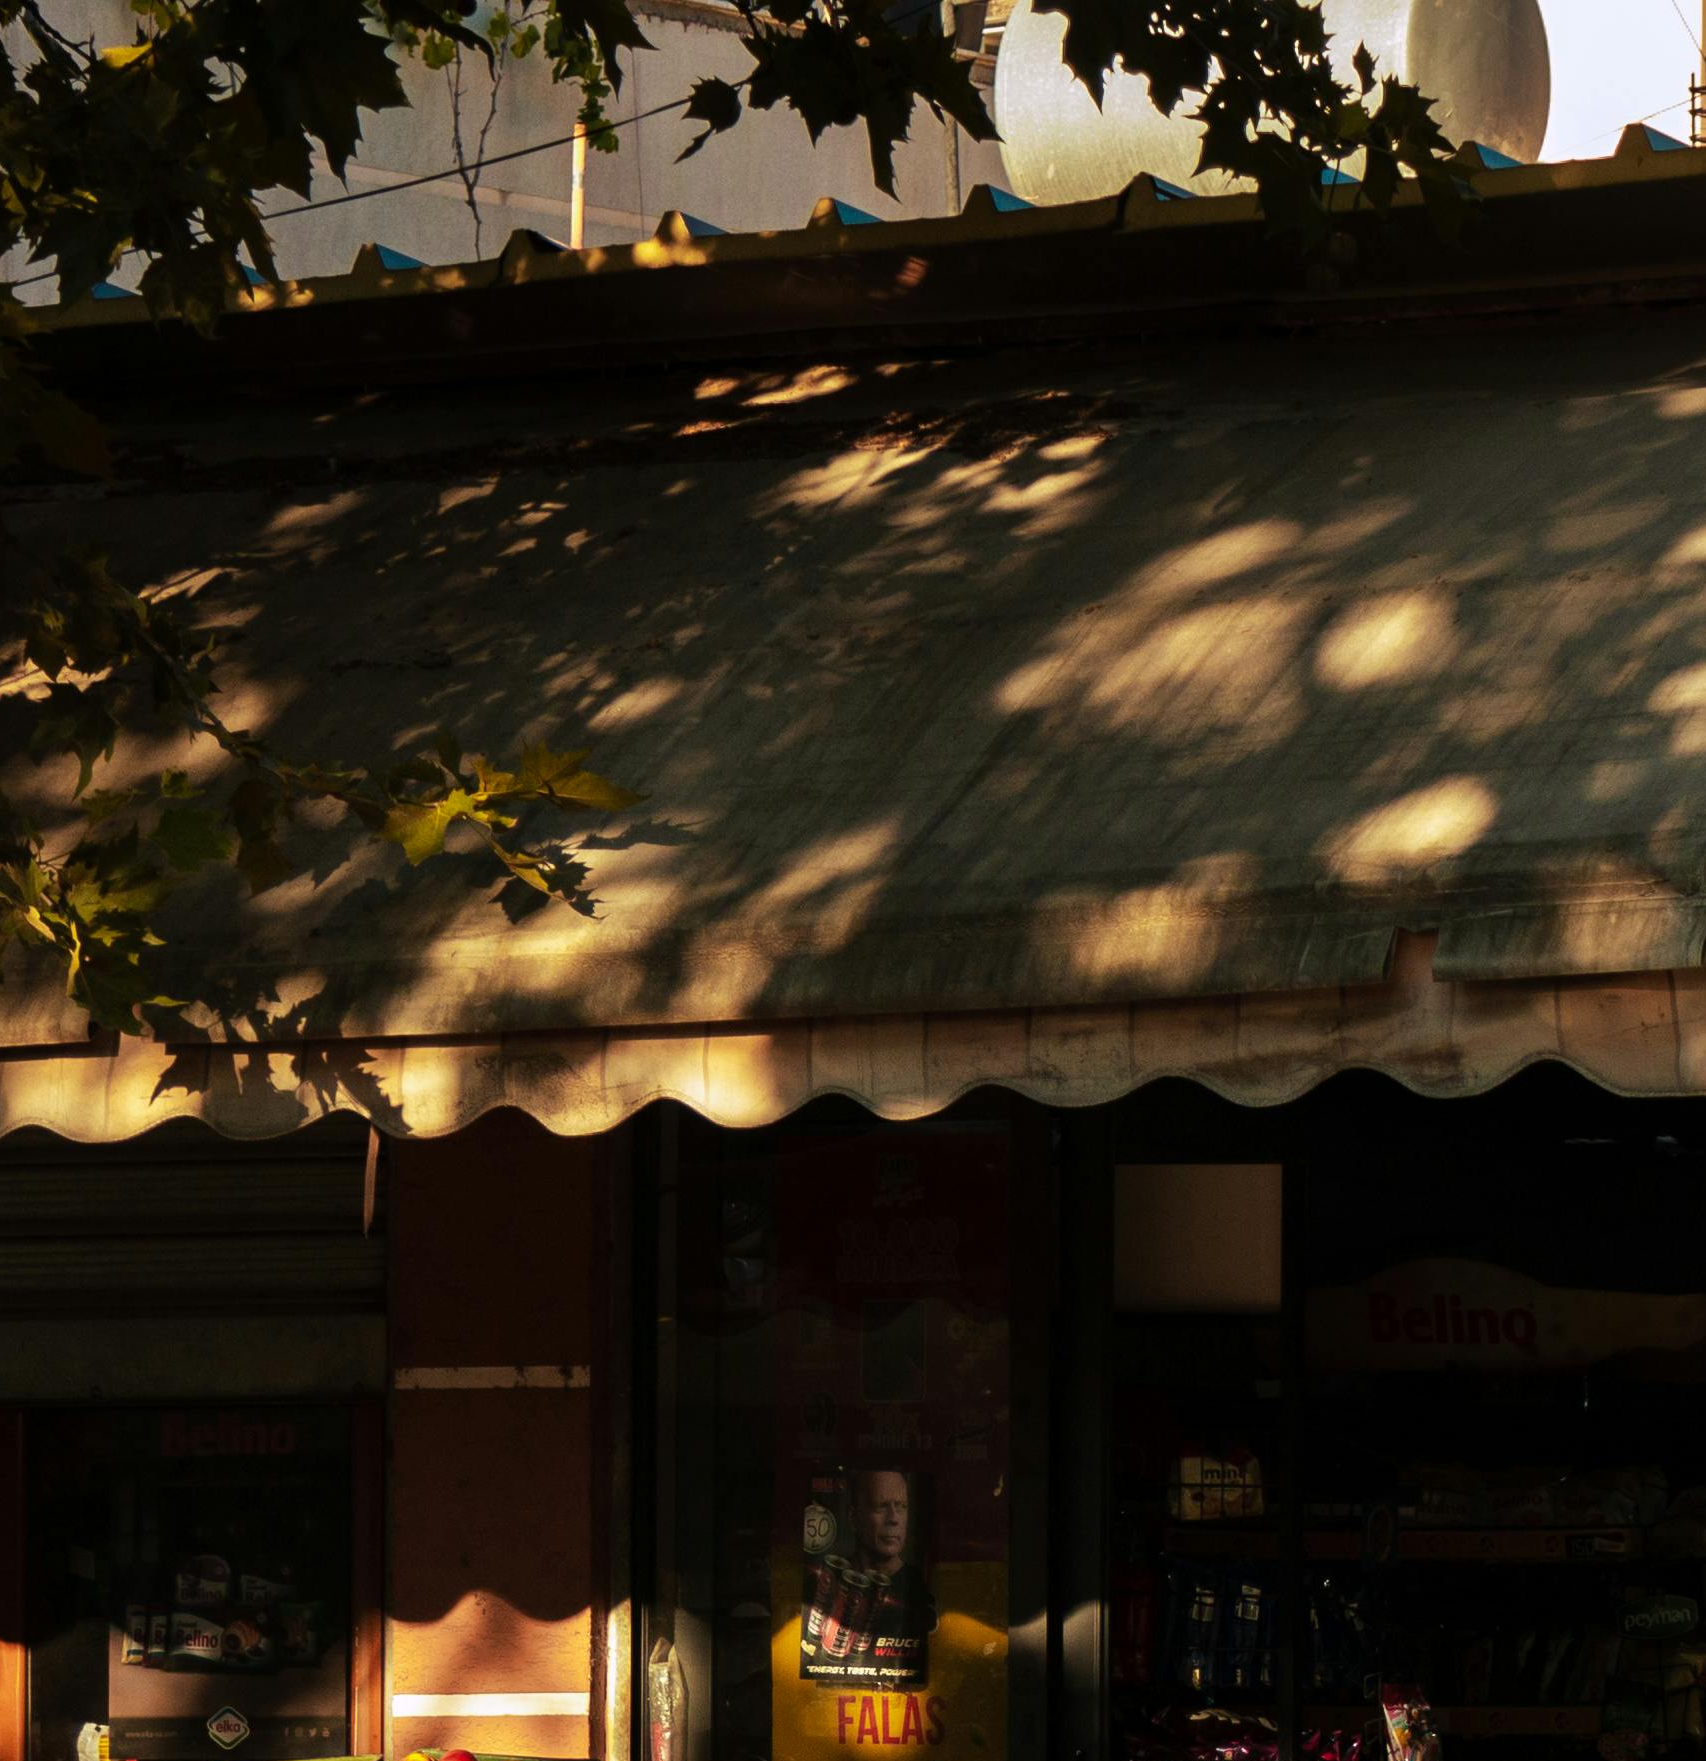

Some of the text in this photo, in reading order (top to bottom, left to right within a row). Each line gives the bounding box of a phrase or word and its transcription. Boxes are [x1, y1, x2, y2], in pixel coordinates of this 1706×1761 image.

[1368, 1293, 1538, 1345] Belino
[807, 1519, 830, 1538] 50
[1625, 1608, 1691, 1632] peyman
[876, 1637, 920, 1648] BRUCE
[216, 1721, 241, 1733] elka
[838, 1695, 946, 1745] FALAS
